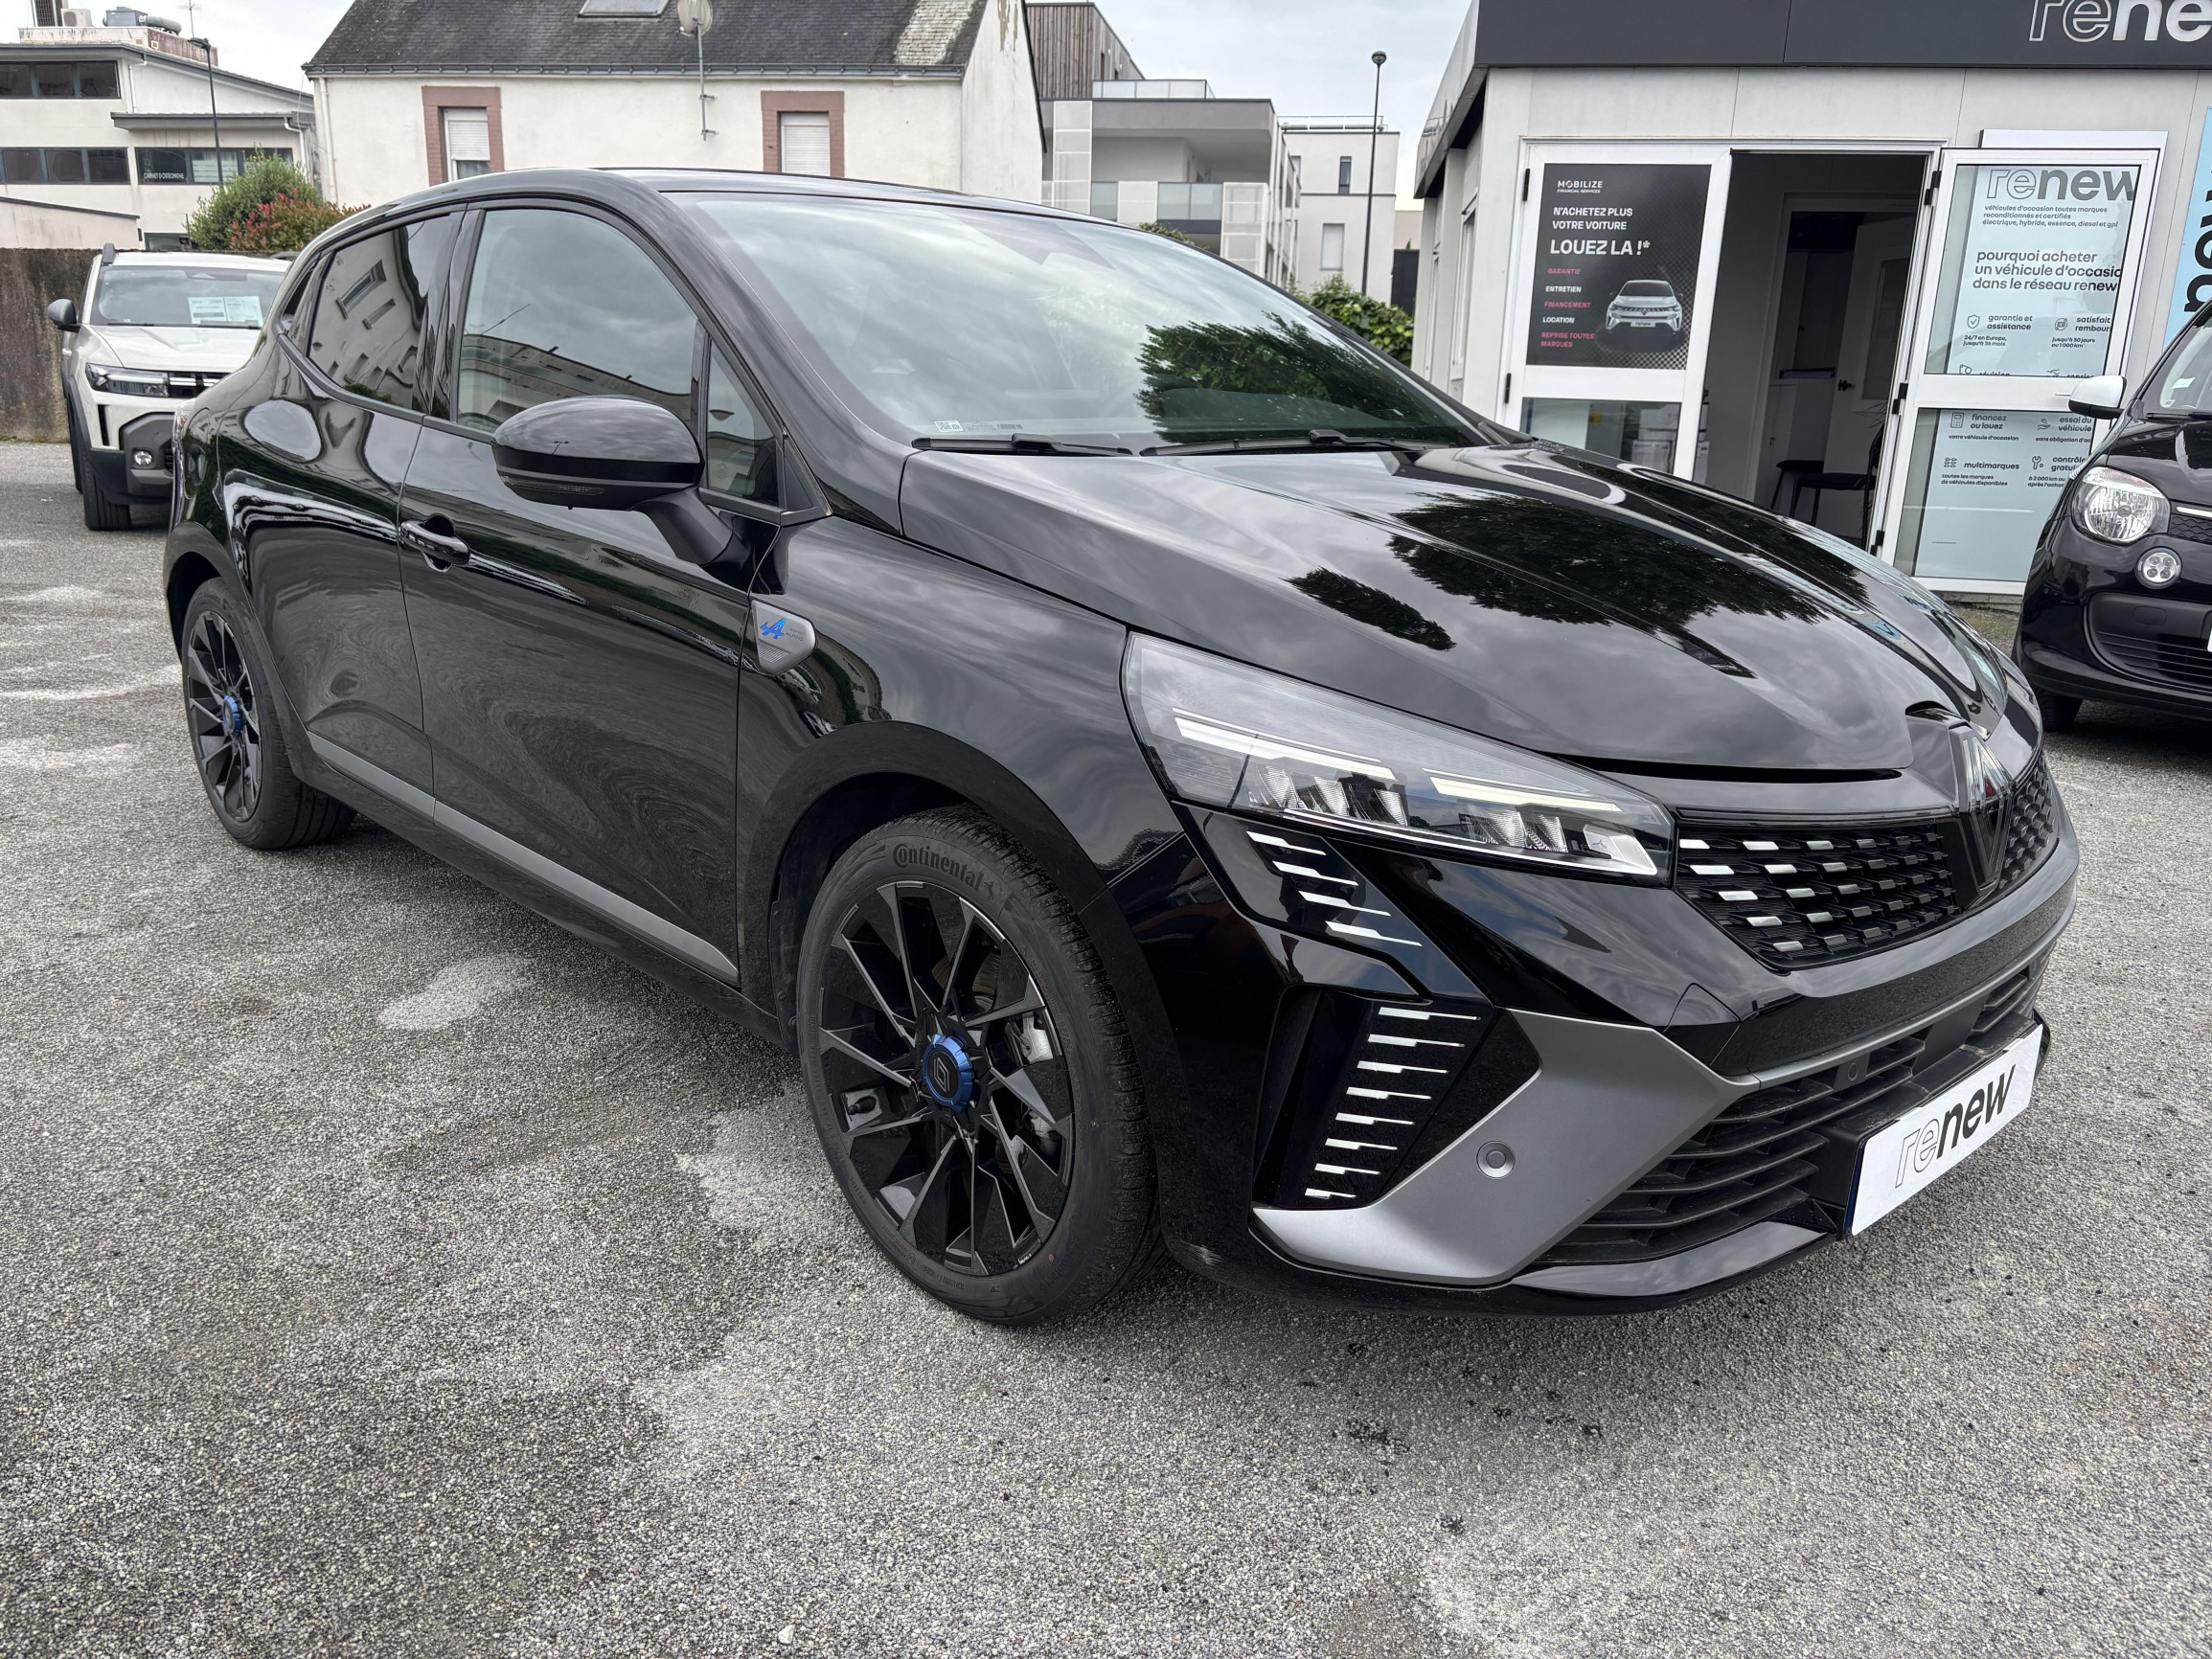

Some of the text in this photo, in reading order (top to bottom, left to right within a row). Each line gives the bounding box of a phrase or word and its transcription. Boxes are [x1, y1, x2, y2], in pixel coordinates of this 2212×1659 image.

[1557, 180, 1603, 188] MOBILIZE
[1986, 169, 2134, 201] renew
[1553, 207, 1633, 217] N'ACHETEZ PLUS
[1552, 221, 1627, 230] VOTRE VOITURE
[1550, 239, 1608, 255] LOUEZ
[1611, 240, 1633, 255] LA
[1977, 250, 2097, 263] pourquoi acheter
[1975, 266, 1992, 274] un
[1995, 264, 2053, 276] véhicule
[1973, 278, 2117, 291] dans le réseau renew
[1964, 462, 2020, 470] multimarques
[893, 843, 984, 891] Continental
[1895, 1064, 2016, 1189] renew
